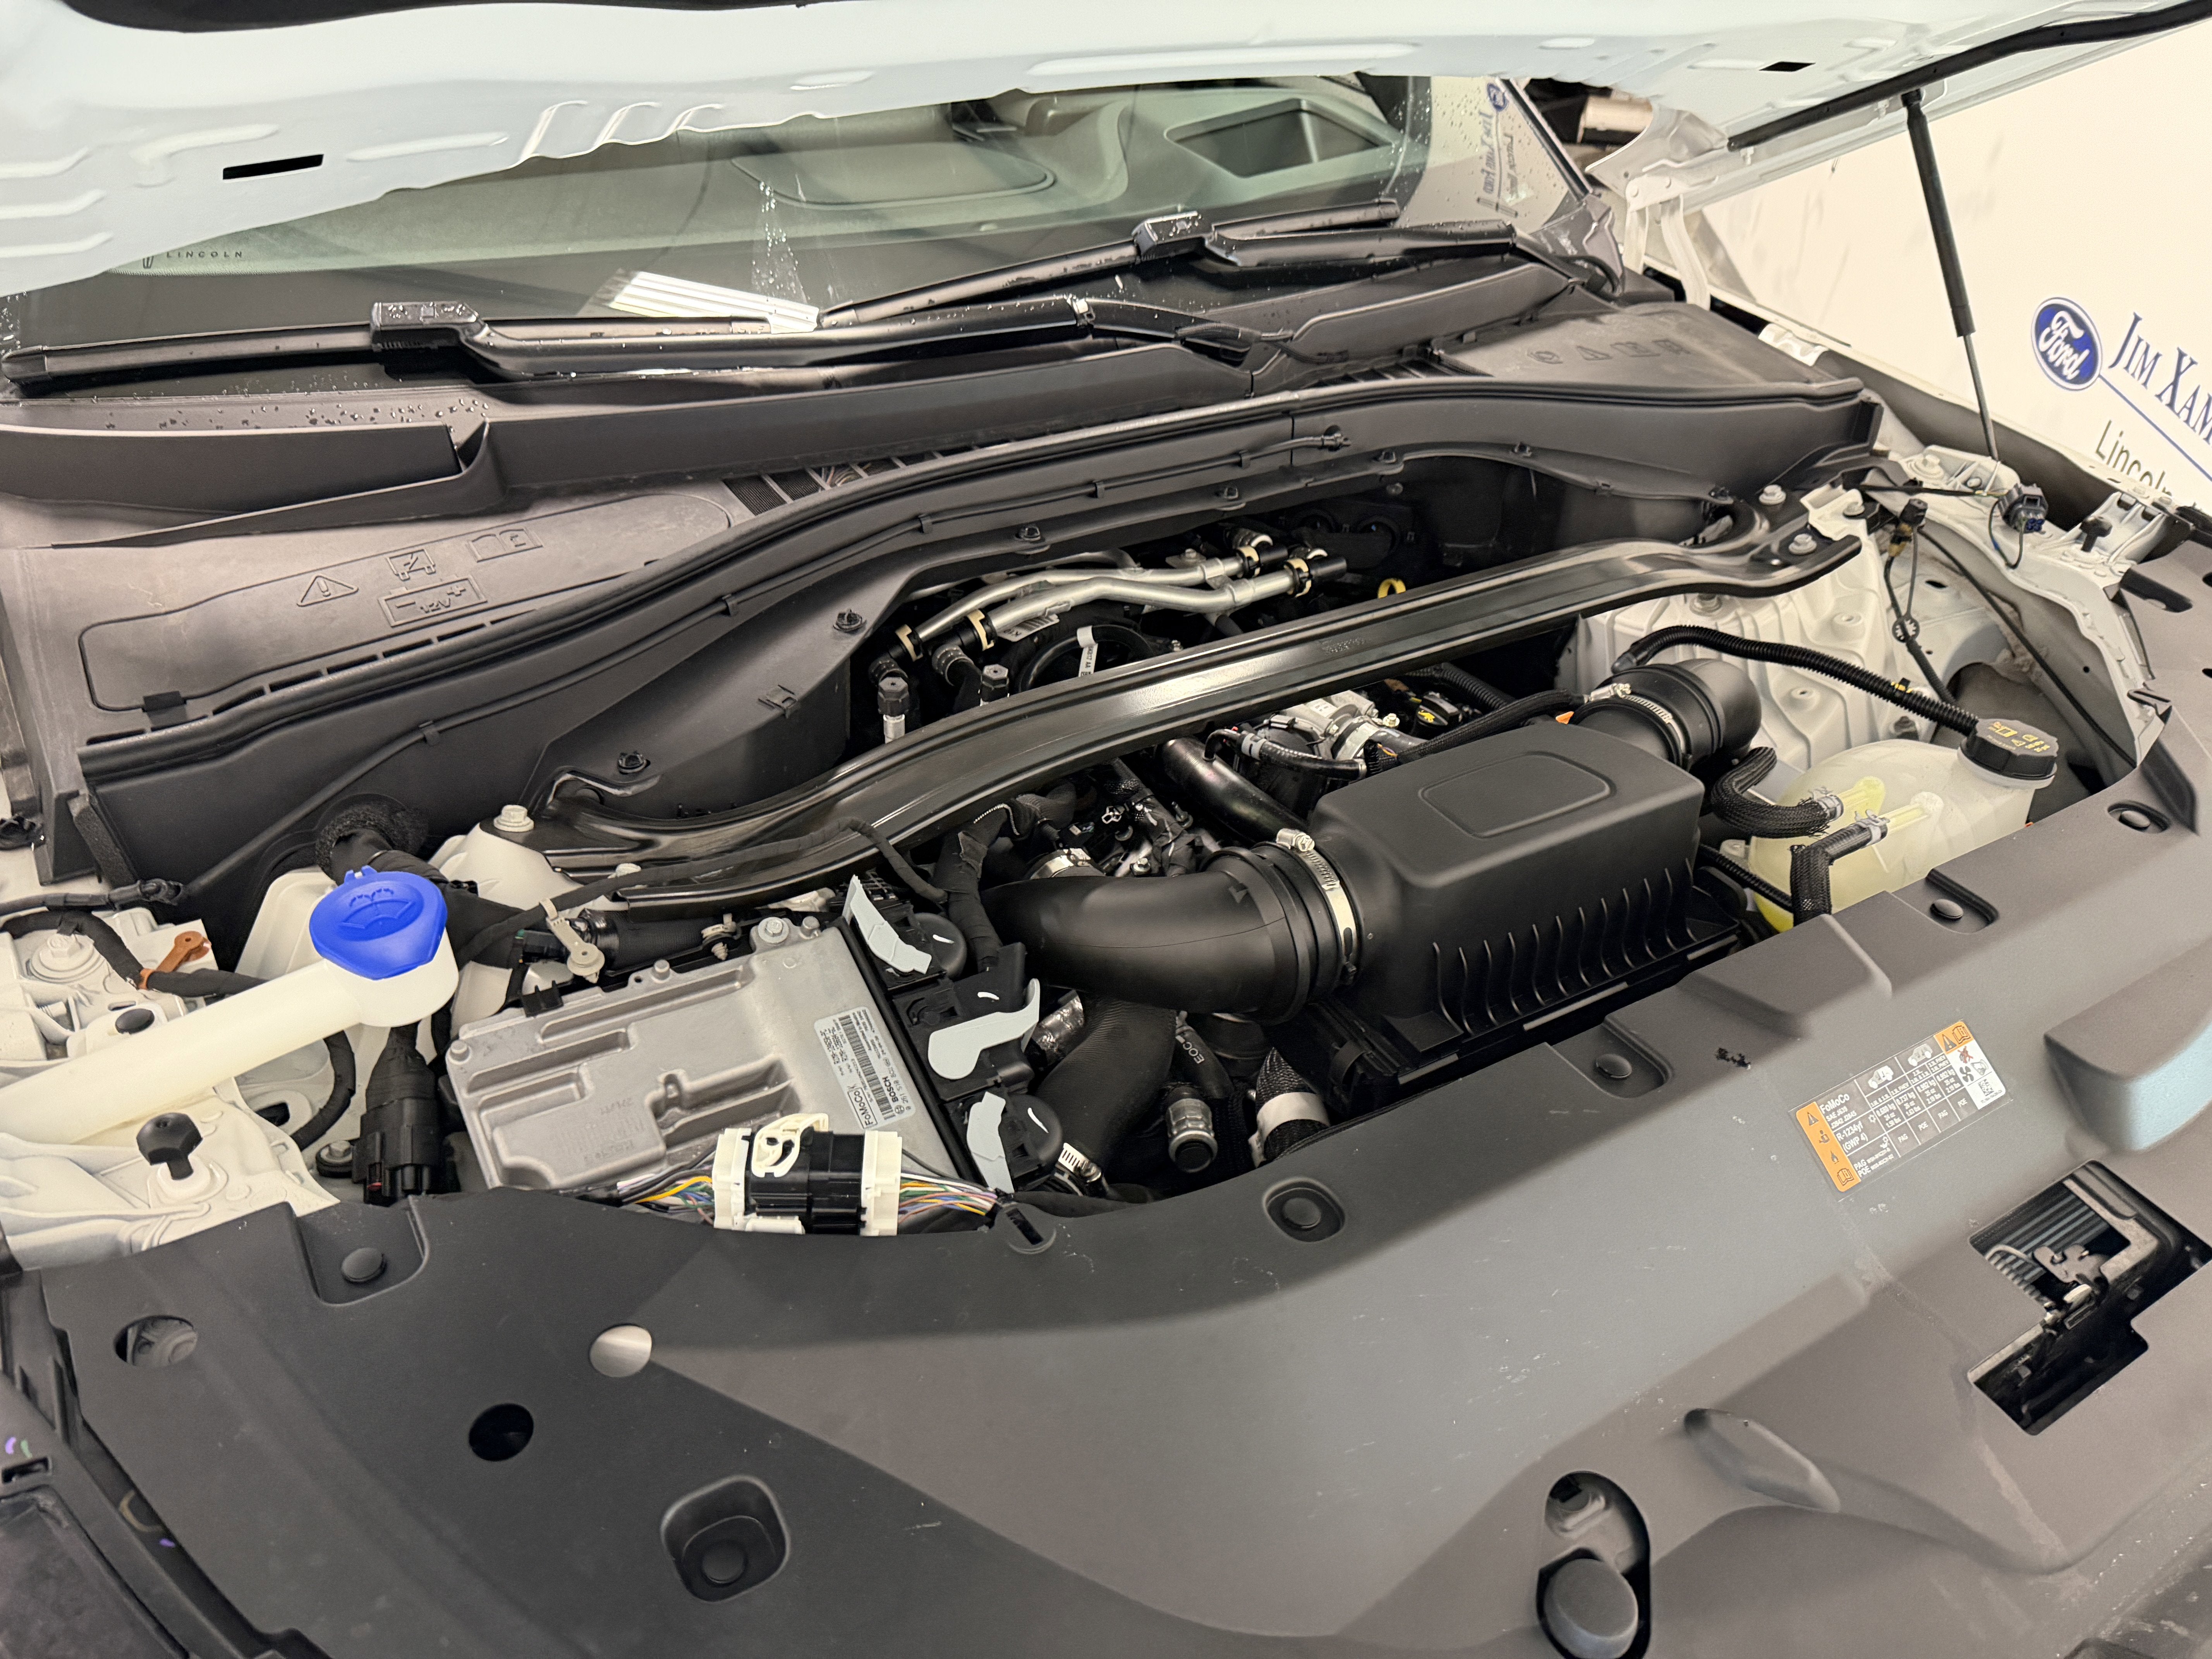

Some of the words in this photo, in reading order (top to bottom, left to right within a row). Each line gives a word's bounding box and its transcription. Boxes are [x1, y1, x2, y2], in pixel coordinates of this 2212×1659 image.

[2039, 310, 2090, 380] Ford
[1183, 1042, 1205, 1064] EOC
[882, 1076, 898, 1103] BOSCH
[854, 1091, 873, 1126] FoMoCo
[1819, 1094, 1850, 1114] FoMoCo
[1826, 1112, 1837, 1121] SAE
[1938, 1110, 1948, 1119] PAG
[1836, 1121, 1863, 1141] R-1234yf
[1918, 1121, 1928, 1130] POE
[1843, 1136, 1860, 1152] (GWP
[1860, 1132, 1868, 1141] 4)
[1898, 1134, 1908, 1143] PAG
[1854, 1159, 1867, 1170] PAG
[1858, 1166, 1871, 1177] POE
